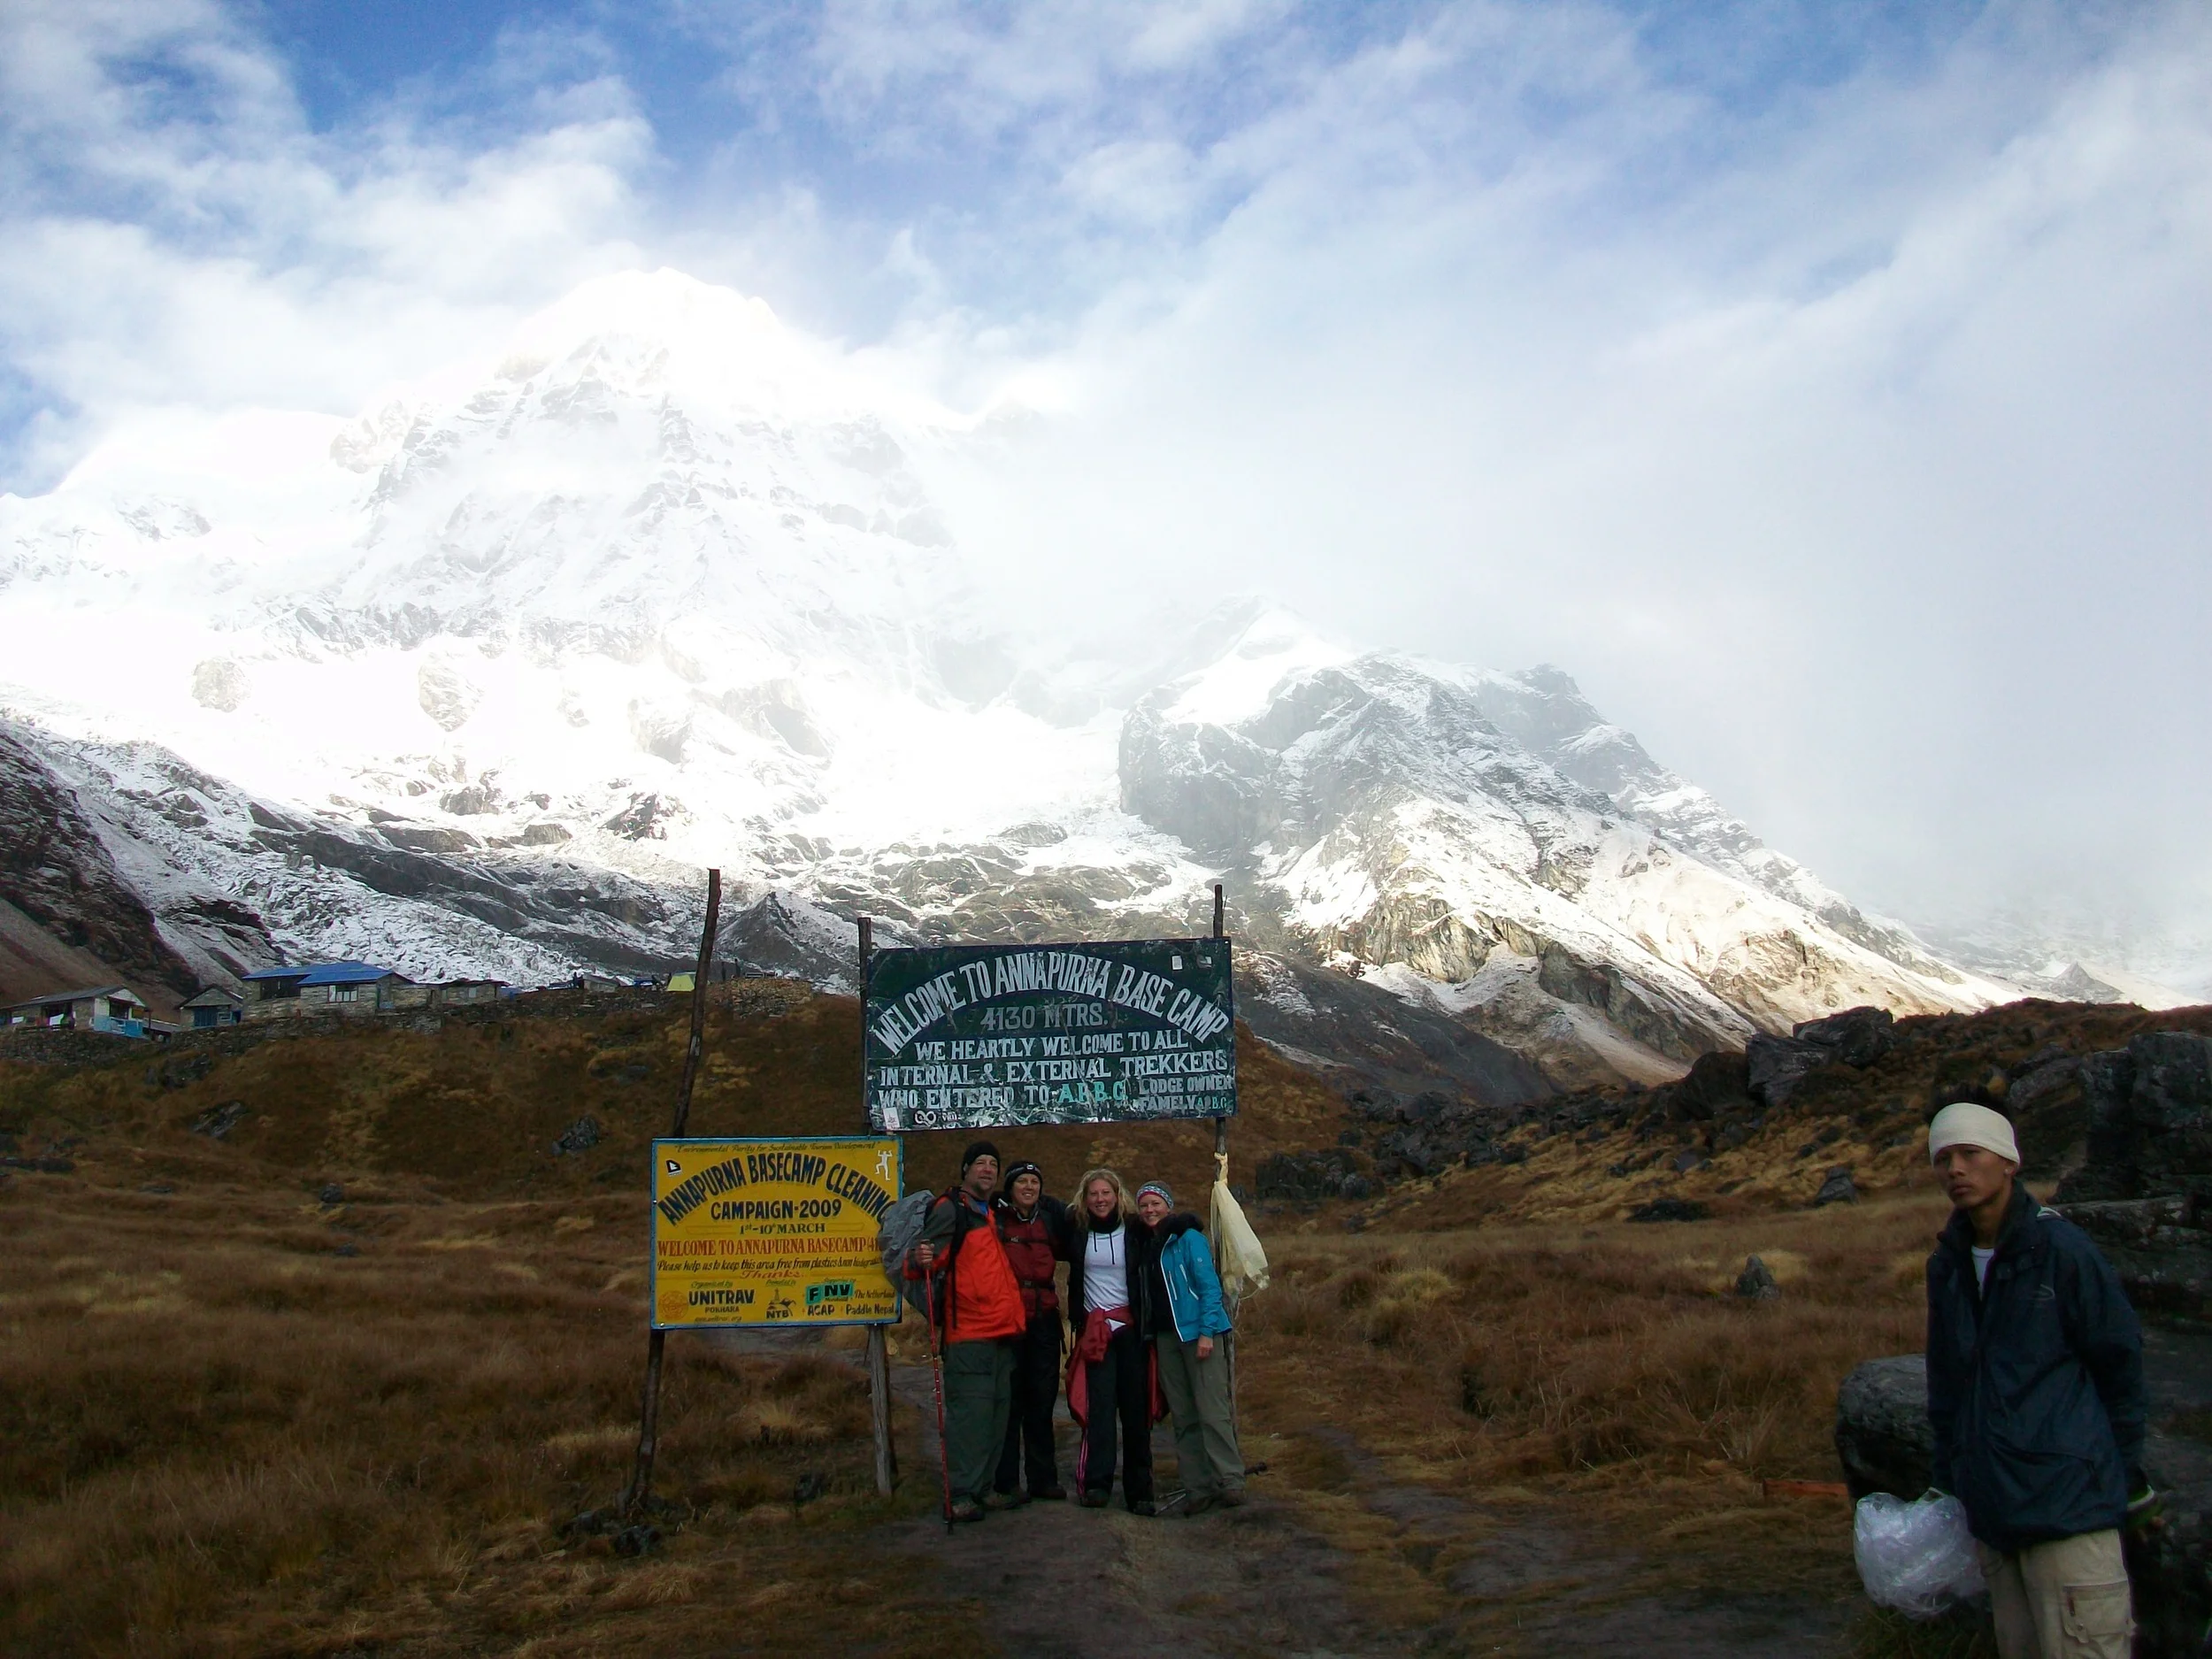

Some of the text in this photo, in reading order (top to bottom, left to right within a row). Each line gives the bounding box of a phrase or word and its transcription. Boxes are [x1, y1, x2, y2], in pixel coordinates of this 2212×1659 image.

[874, 951, 1229, 1056] WELCOME TO ANNAPURNA BASE CAMP
[980, 1002, 1108, 1031] 4130 MTRS.
[915, 1028, 1188, 1061] WE HEARTLY WELCOME TO ALL
[879, 1064, 974, 1087] INTERNAL
[1006, 1057, 1111, 1083] EXTERNAL
[1120, 1049, 1228, 1076] TREKKERS
[1139, 1074, 1233, 1094] LODGE OWNER
[878, 1088, 918, 1109] WHO
[926, 1087, 1014, 1110] ENTERED
[1024, 1086, 1049, 1106] TO
[657, 1157, 747, 1226] ANNAPURNA
[747, 1152, 826, 1186] BASECAMP
[777, 1223, 826, 1234] MARCH
[657, 1239, 716, 1256] WELCOME
[718, 1239, 734, 1256] TO
[735, 1238, 804, 1255] ANNAPURNA
[657, 1259, 681, 1271] Please
[683, 1260, 701, 1273] help
[703, 1262, 712, 1271] us
[721, 1259, 740, 1272] keep
[741, 1258, 756, 1270] this
[757, 1261, 775, 1270] area
[776, 1257, 793, 1271] free
[792, 1257, 810, 1270] from
[810, 1256, 837, 1271] plastics
[766, 1310, 790, 1319] NTB
[807, 1304, 835, 1316] ACAP
[846, 1302, 895, 1316] Paddle Nepal
